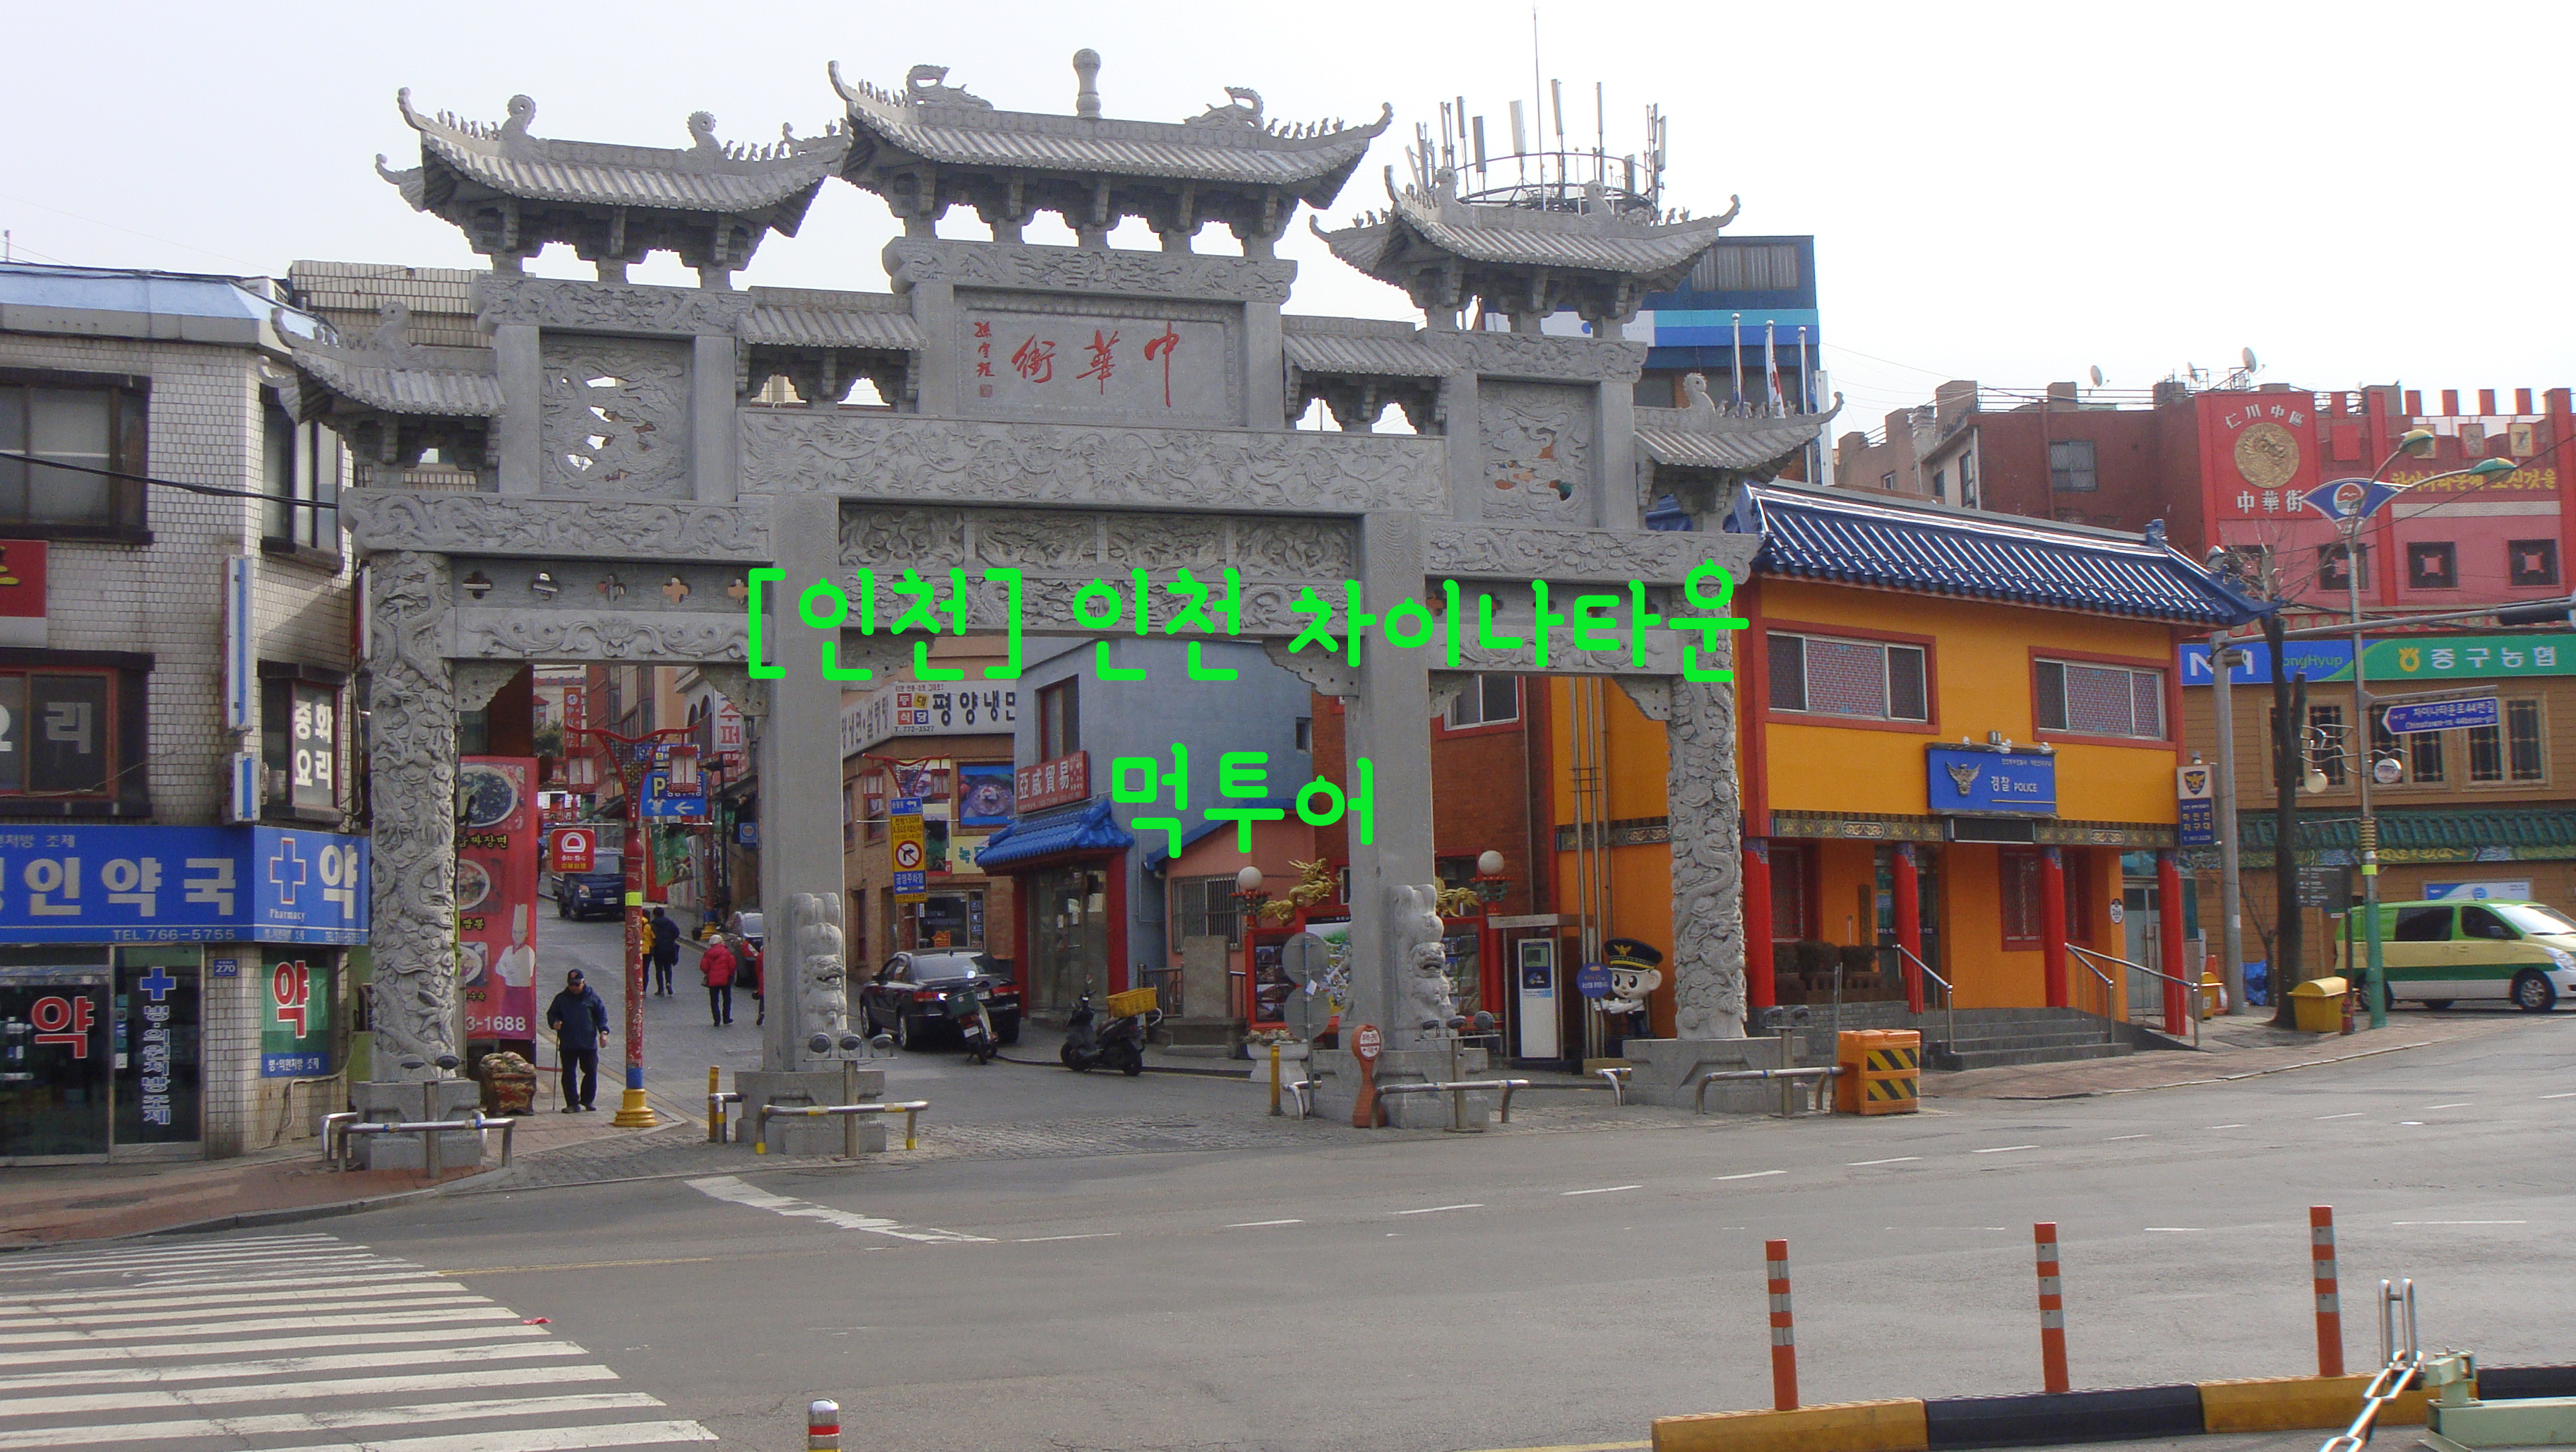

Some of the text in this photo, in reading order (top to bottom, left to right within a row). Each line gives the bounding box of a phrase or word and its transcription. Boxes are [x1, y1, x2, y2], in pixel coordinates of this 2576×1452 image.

[2225, 403, 2306, 429] 仁川中區
[2236, 489, 2303, 514] 中華街
[2283, 653, 2343, 670] ongHyup
[2431, 645, 2557, 670] 중구농협
[720, 703, 741, 744] 수퍼
[900, 711, 927, 723] 식당
[653, 778, 666, 797] P
[1991, 776, 2037, 792] 경찰 POLICE
[46, 834, 75, 847] 조제
[0, 857, 236, 917] 인약국
[318, 844, 358, 919] 약
[270, 908, 305, 922] Pharmacy
[272, 960, 309, 1039] 약
[31, 996, 94, 1059] 약
[307, 1057, 320, 1070] 조제
